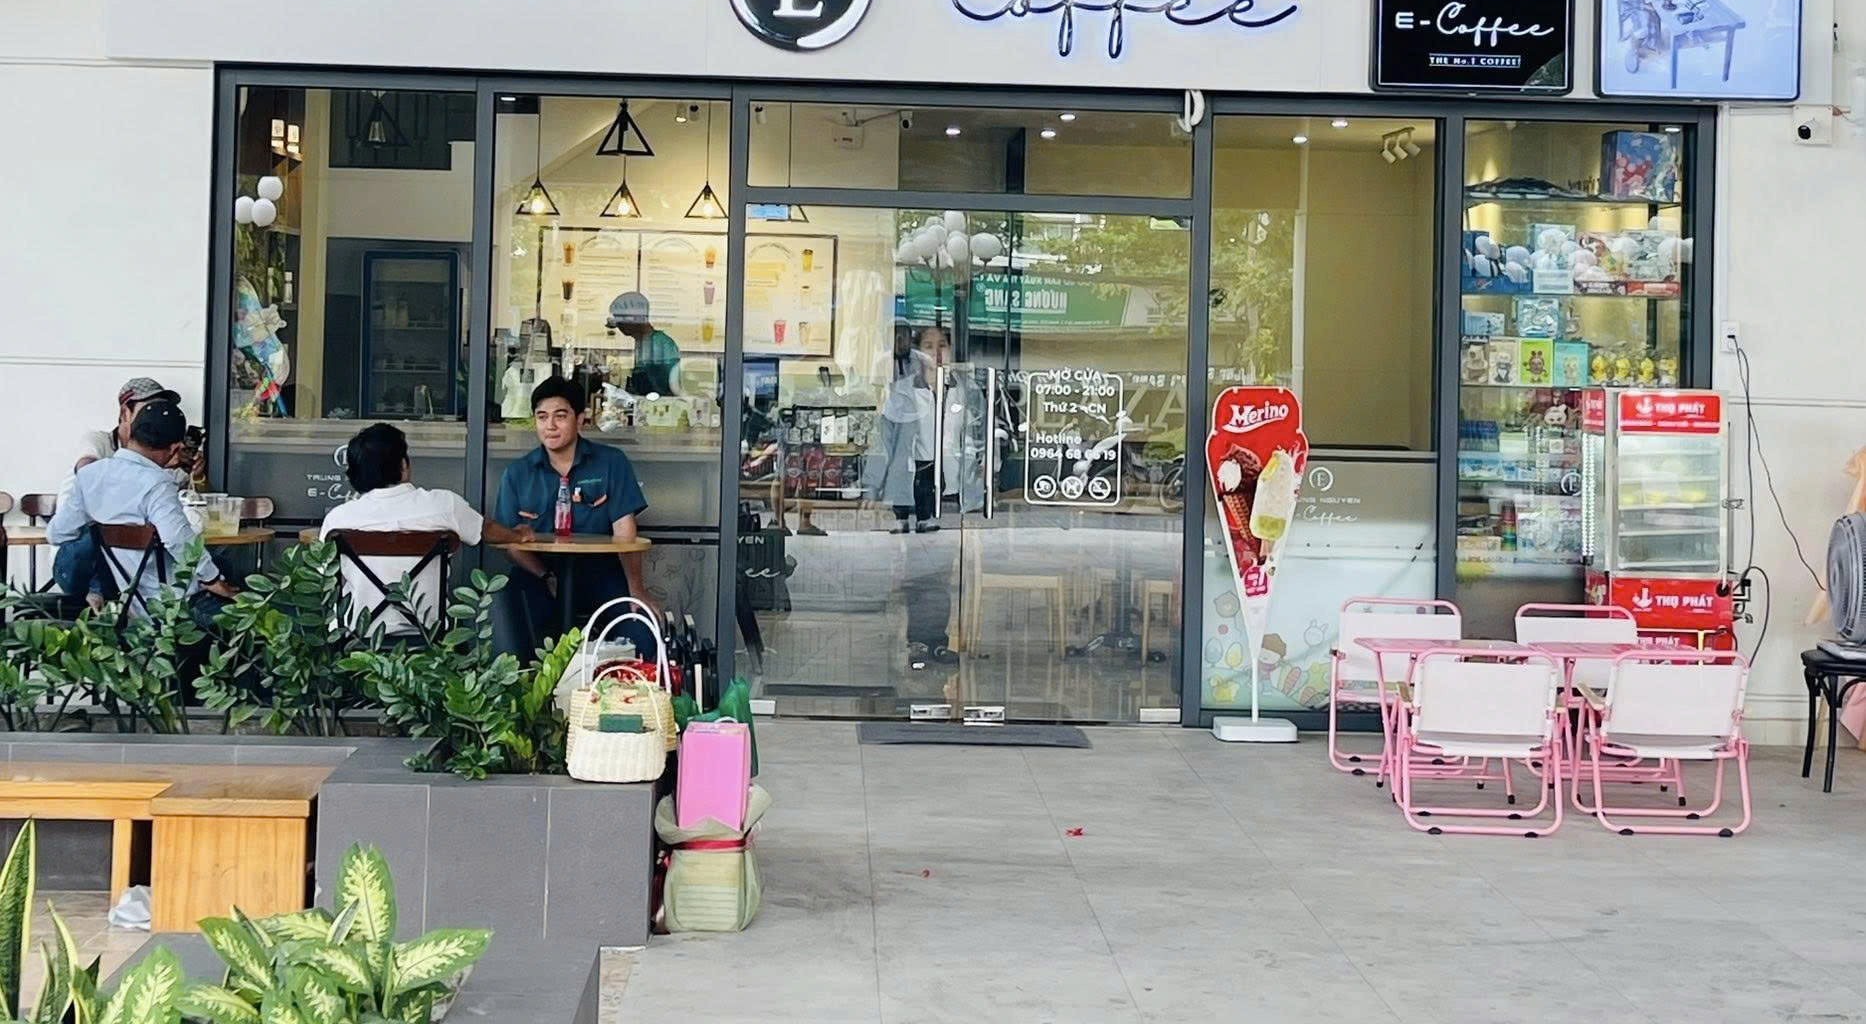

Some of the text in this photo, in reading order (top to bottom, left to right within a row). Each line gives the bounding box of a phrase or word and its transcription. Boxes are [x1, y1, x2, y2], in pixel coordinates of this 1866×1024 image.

[1430, 56, 1449, 65] THE
[1035, 384, 1071, 395] 07:00
[1082, 385, 1115, 396] 21:00
[1043, 401, 1067, 413] Thứ
[1087, 403, 1107, 414] CN
[1229, 400, 1289, 426] Merino
[1103, 450, 1116, 461] 19
[737, 536, 765, 545] YEN
[1655, 593, 1714, 609] THỌ PHÁT
